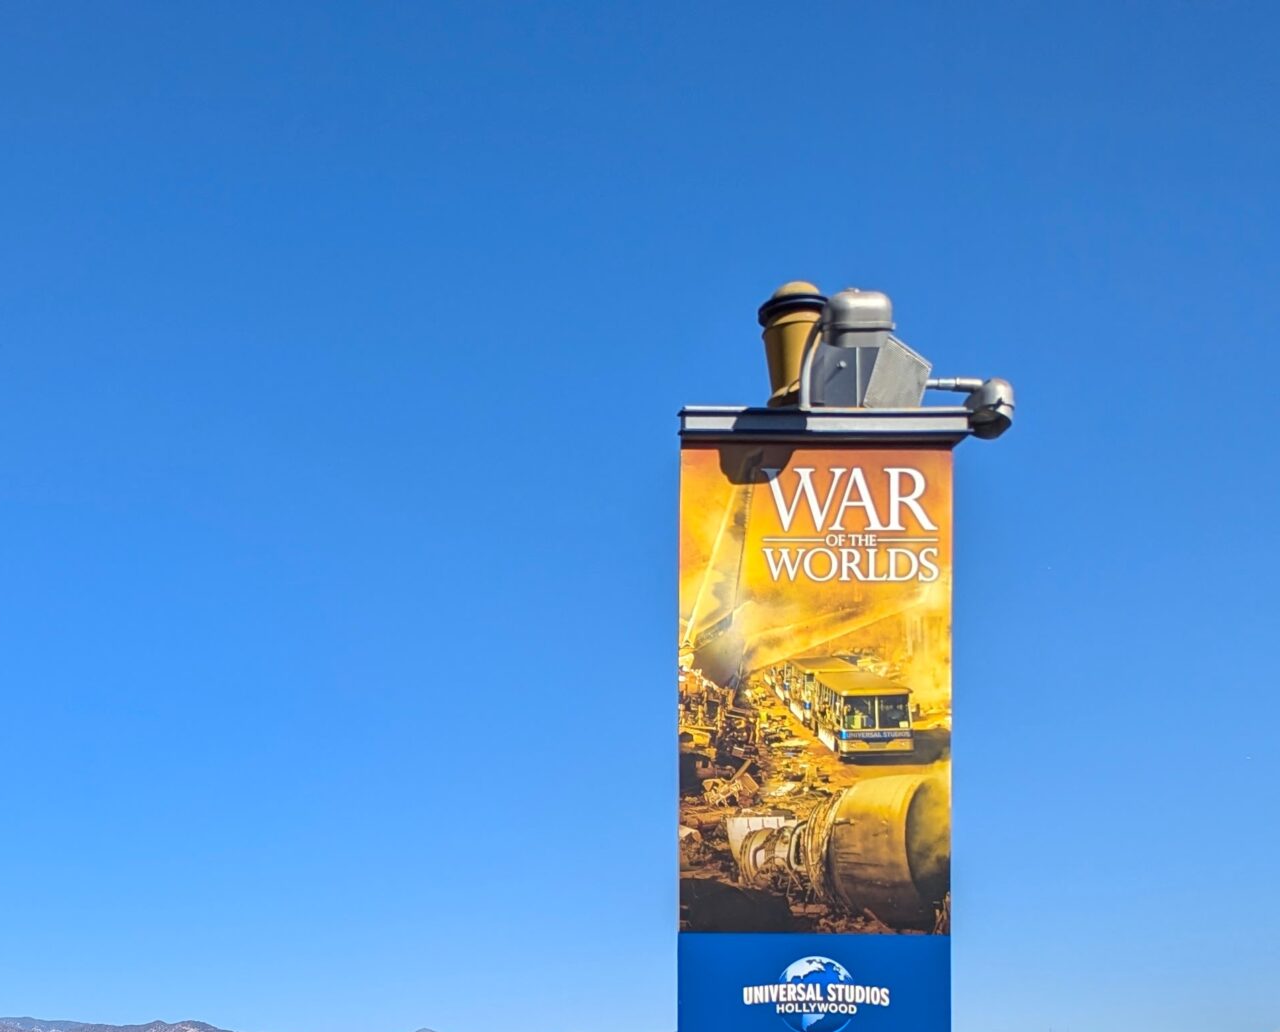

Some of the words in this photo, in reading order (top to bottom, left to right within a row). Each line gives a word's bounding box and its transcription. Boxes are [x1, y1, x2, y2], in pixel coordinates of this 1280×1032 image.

[762, 467, 938, 532] WAR
[825, 534, 845, 546] OF
[848, 534, 877, 546] THE
[763, 547, 939, 582] WORLDS
[743, 983, 823, 1005] UNIVERSAL
[827, 983, 890, 1006] STUDIOS
[776, 1003, 857, 1014] HOLLYWOOD
